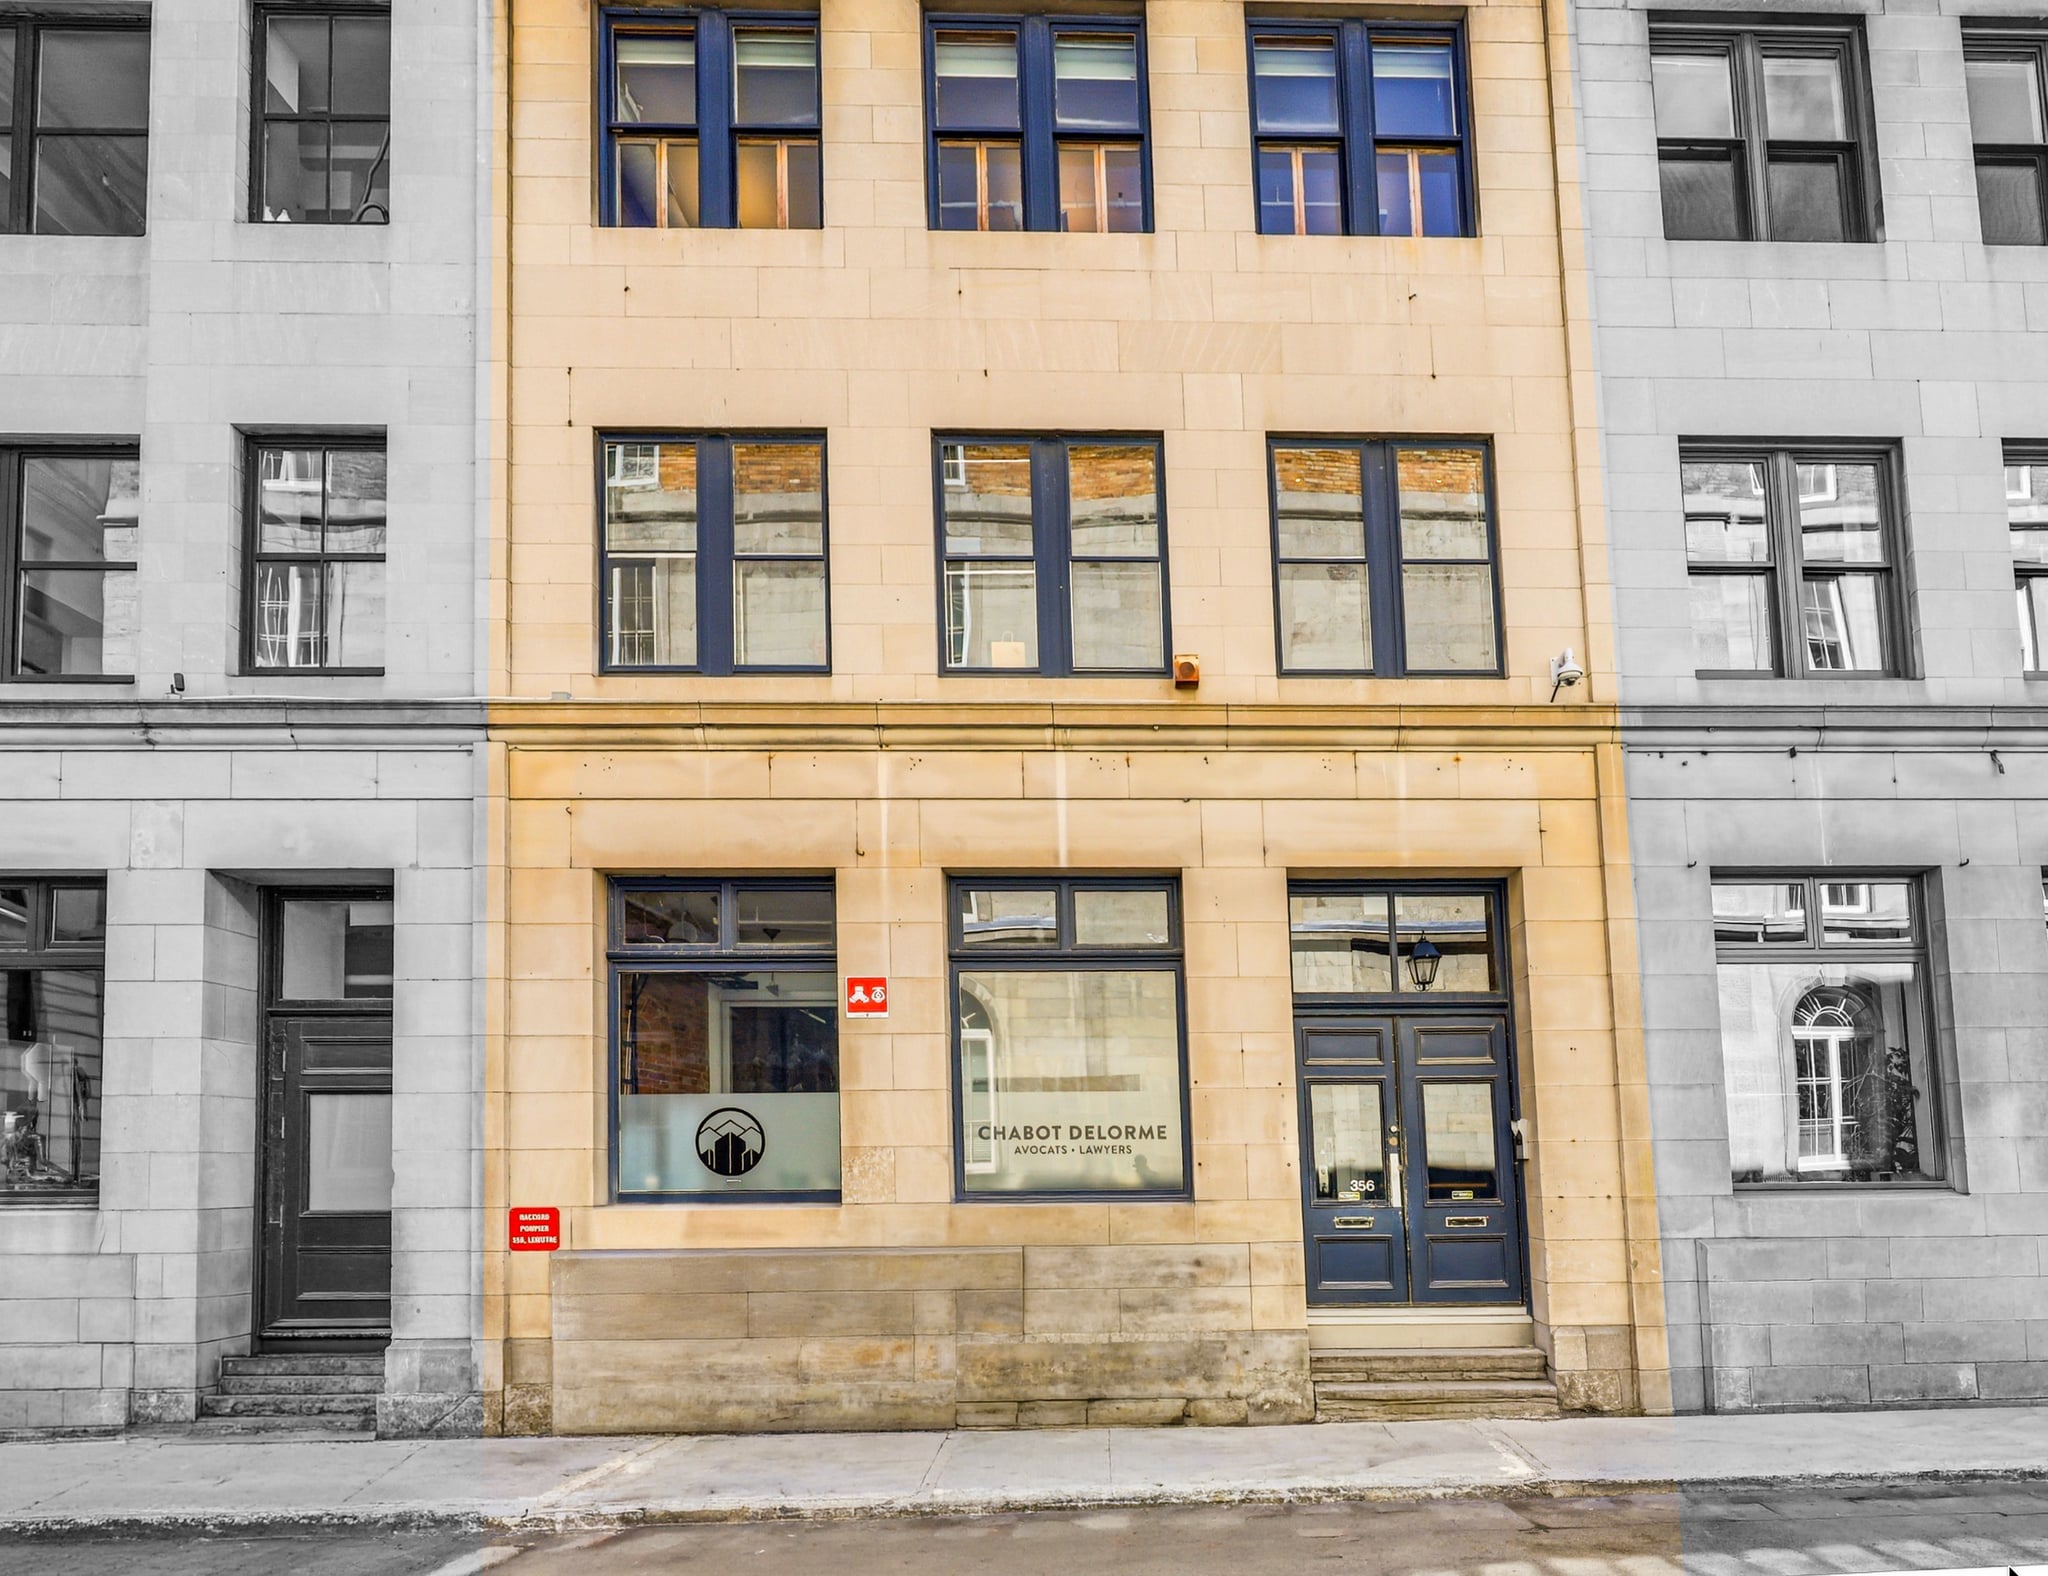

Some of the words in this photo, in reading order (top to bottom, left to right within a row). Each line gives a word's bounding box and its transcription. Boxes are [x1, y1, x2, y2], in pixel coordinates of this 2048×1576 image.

[978, 1125, 1061, 1140] CHABOT
[1069, 1125, 1167, 1140] DELORME
[1014, 1145, 1067, 1155] AVOCATS
[1079, 1145, 1132, 1154] LAWYERS
[1350, 1179, 1375, 1192] 356
